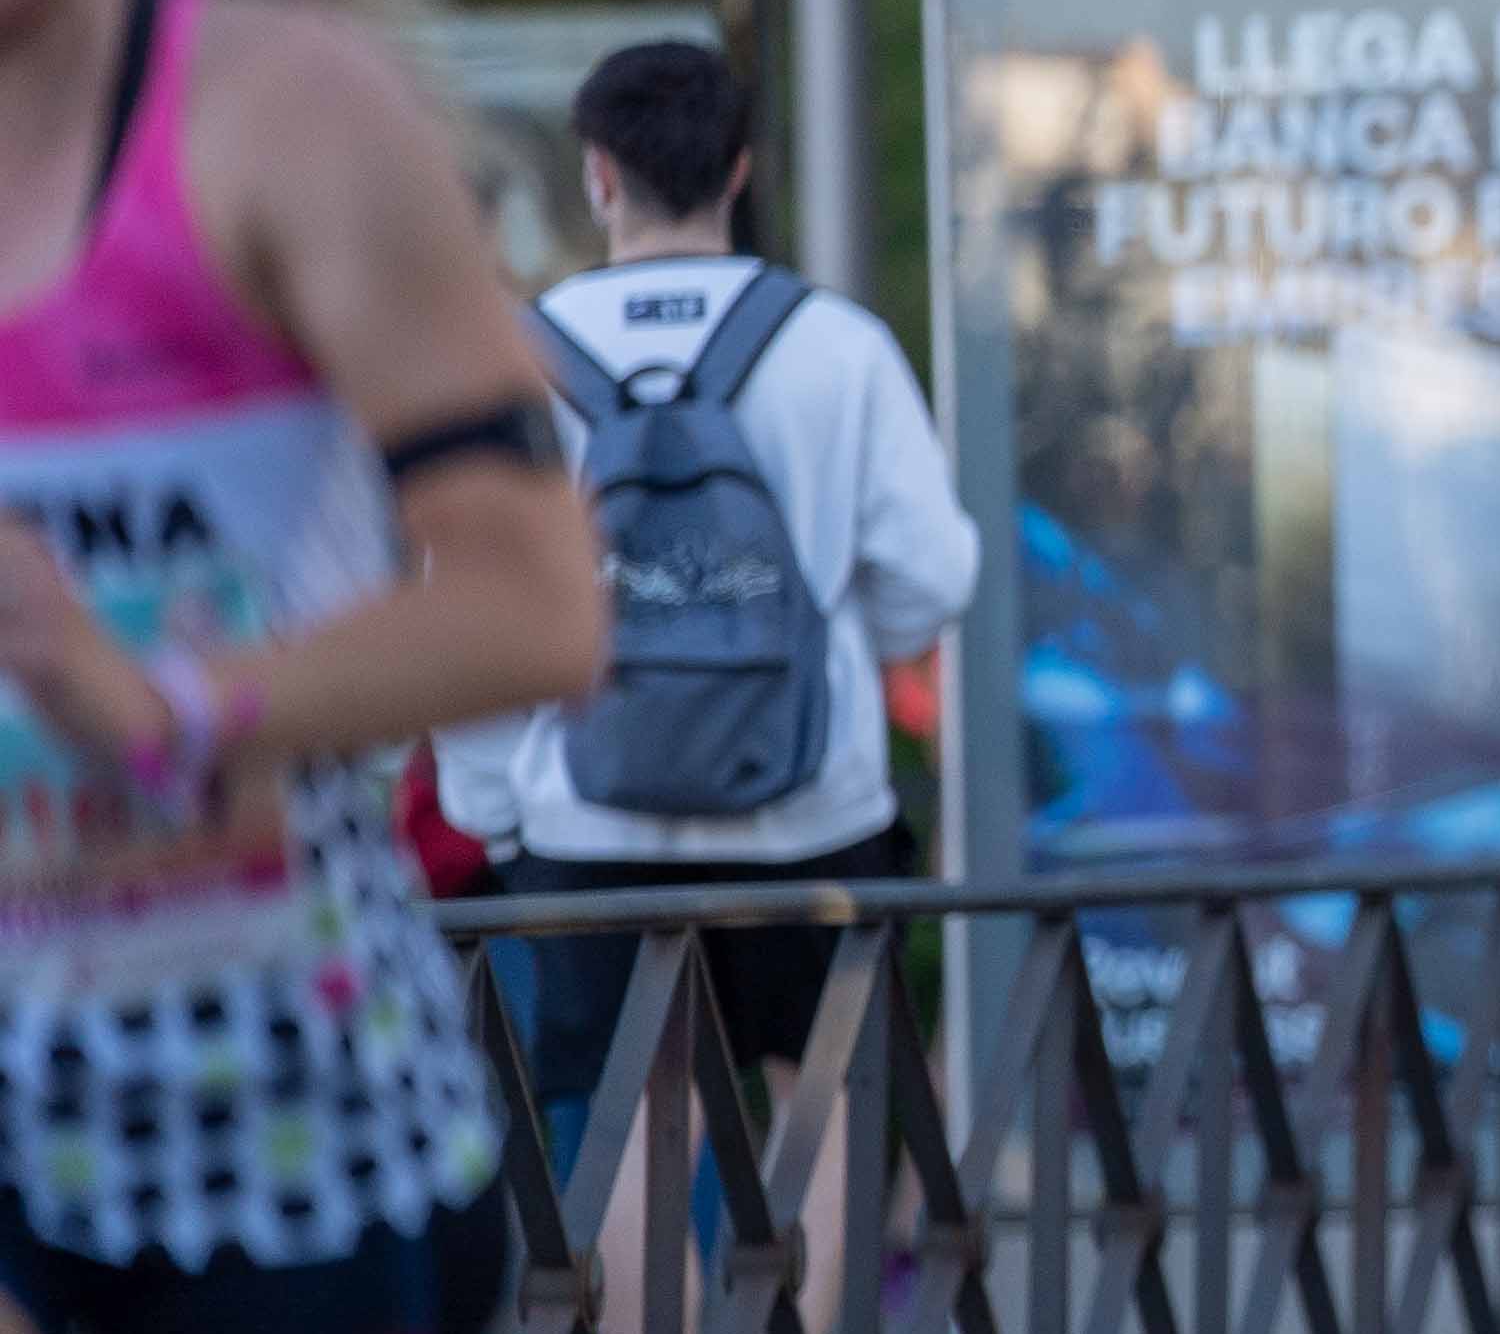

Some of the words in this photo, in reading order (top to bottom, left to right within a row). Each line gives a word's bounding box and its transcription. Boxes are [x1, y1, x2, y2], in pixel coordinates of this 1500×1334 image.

[1196, 7, 1478, 97] LLEGA
[1156, 91, 1475, 177] BANCA
[1094, 173, 1460, 264] FUTURO
